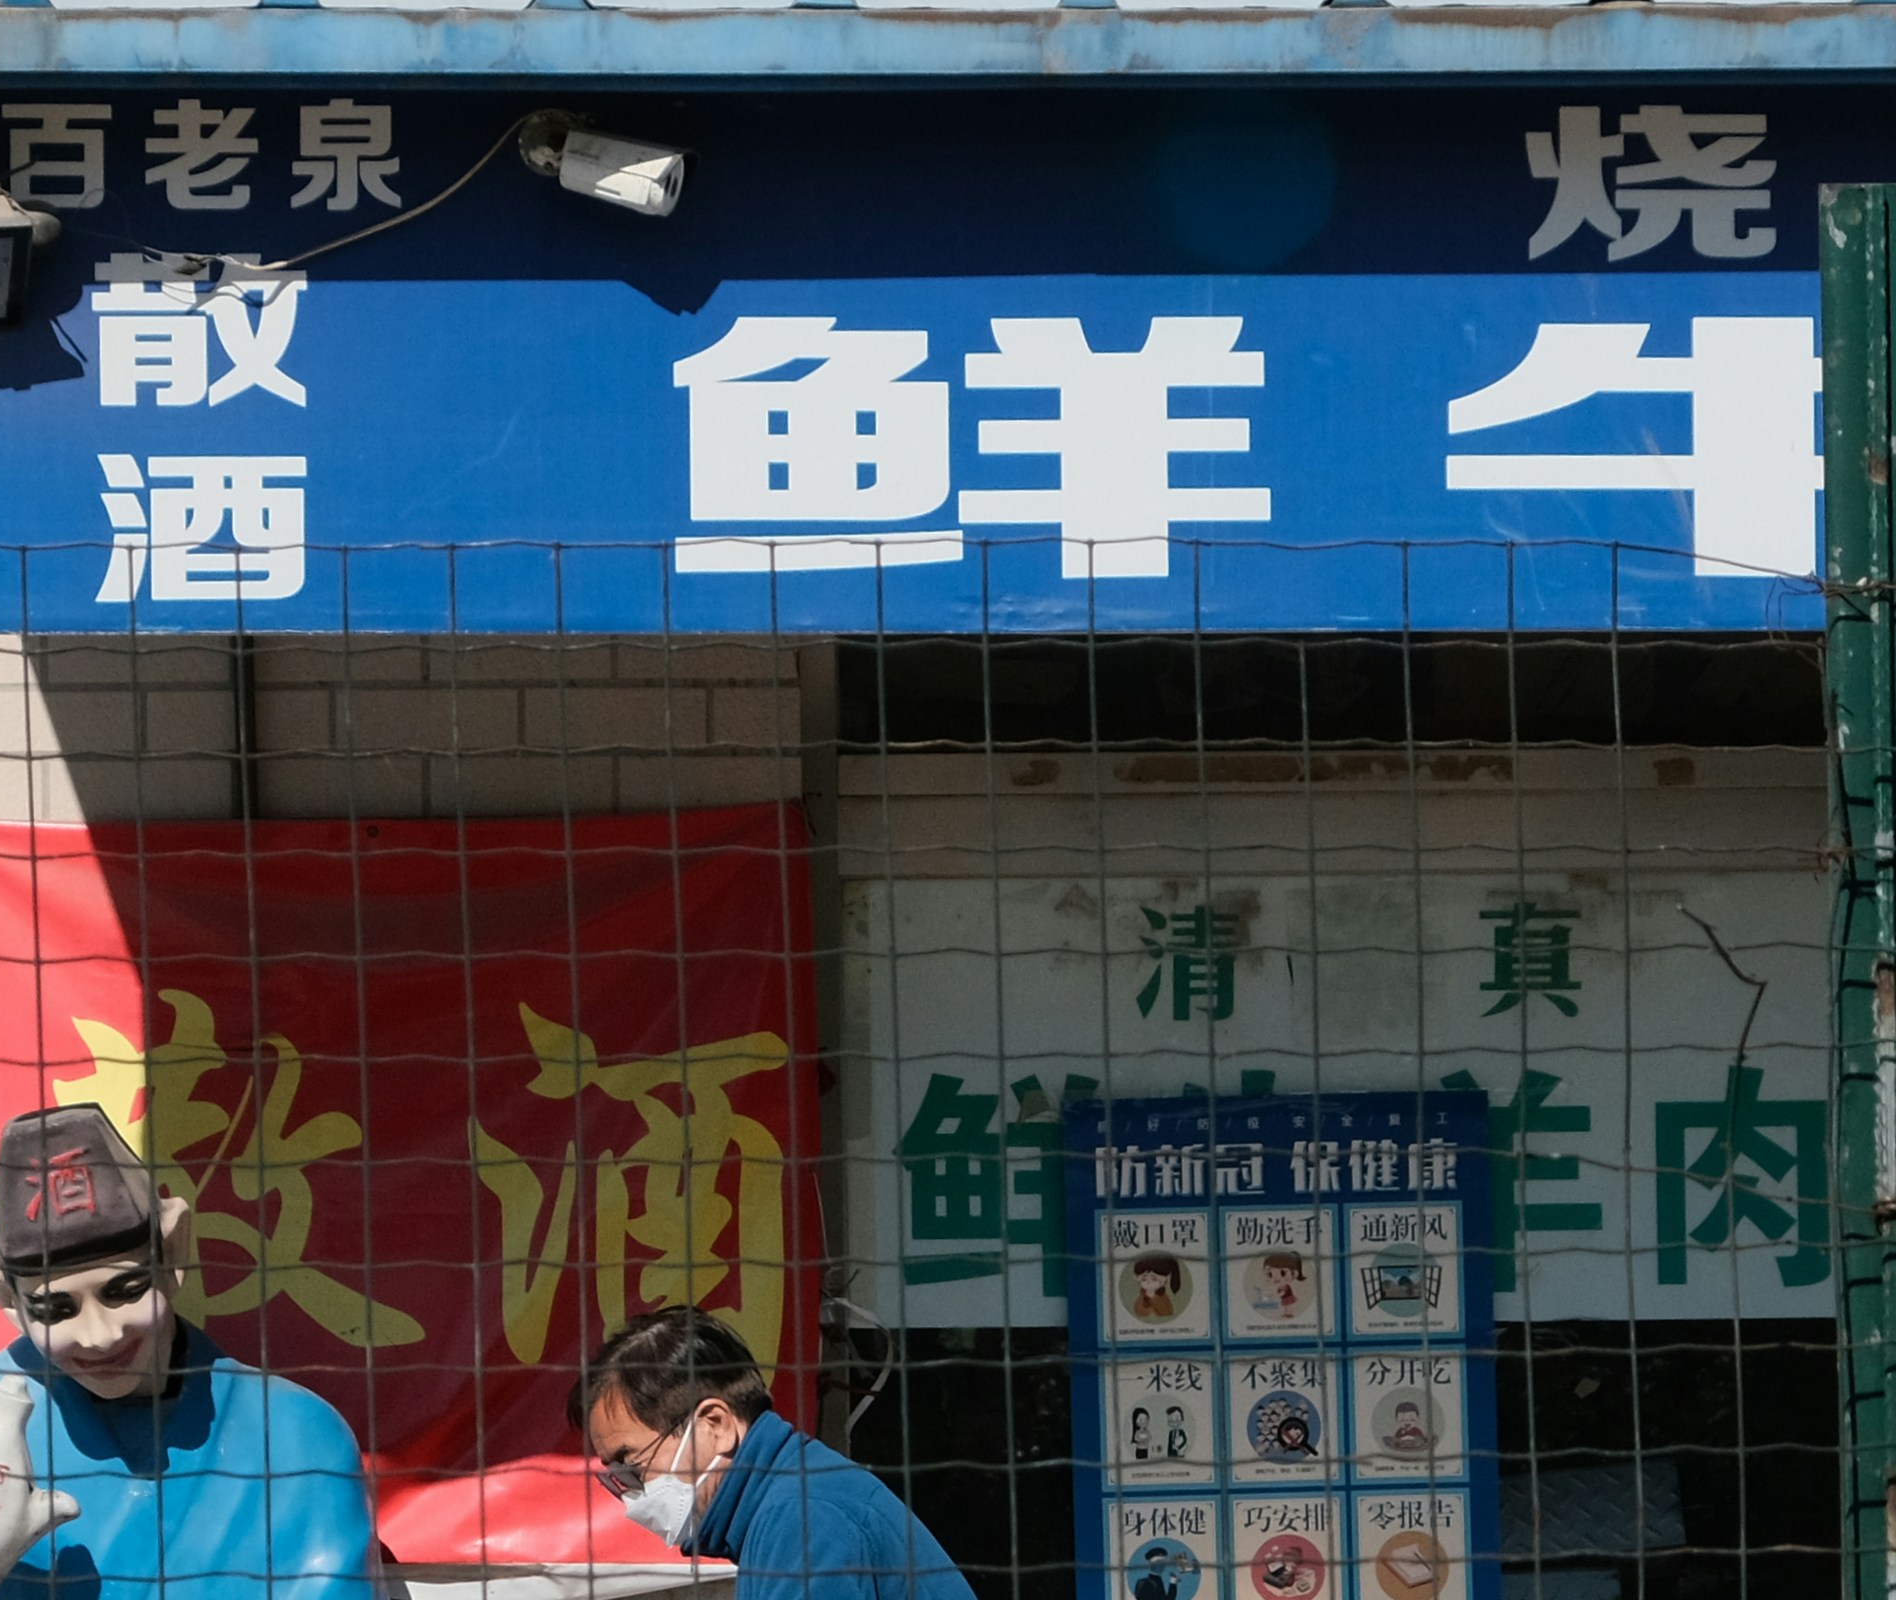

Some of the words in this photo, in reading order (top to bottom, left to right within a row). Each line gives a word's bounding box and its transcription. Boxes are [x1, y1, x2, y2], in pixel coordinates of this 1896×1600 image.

[1, 98, 403, 211] 百老泉
[91, 252, 308, 604] 散酒
[1136, 903, 1583, 1022] 清真
[24, 1147, 97, 1222] 酒
[1094, 1142, 1267, 1199] 防新冠
[1289, 1137, 1459, 1194] 保健康
[1112, 1218, 1201, 1250] 戴口罩
[1235, 1215, 1325, 1247] 勤洗手
[1359, 1211, 1450, 1244] 通新风
[1117, 1361, 1204, 1394] 一米线
[1241, 1360, 1328, 1391] 不聚集
[1123, 1506, 1207, 1539] 身体健
[1243, 1502, 1331, 1533] 巧安排
[1368, 1499, 1456, 1531] 零报告
